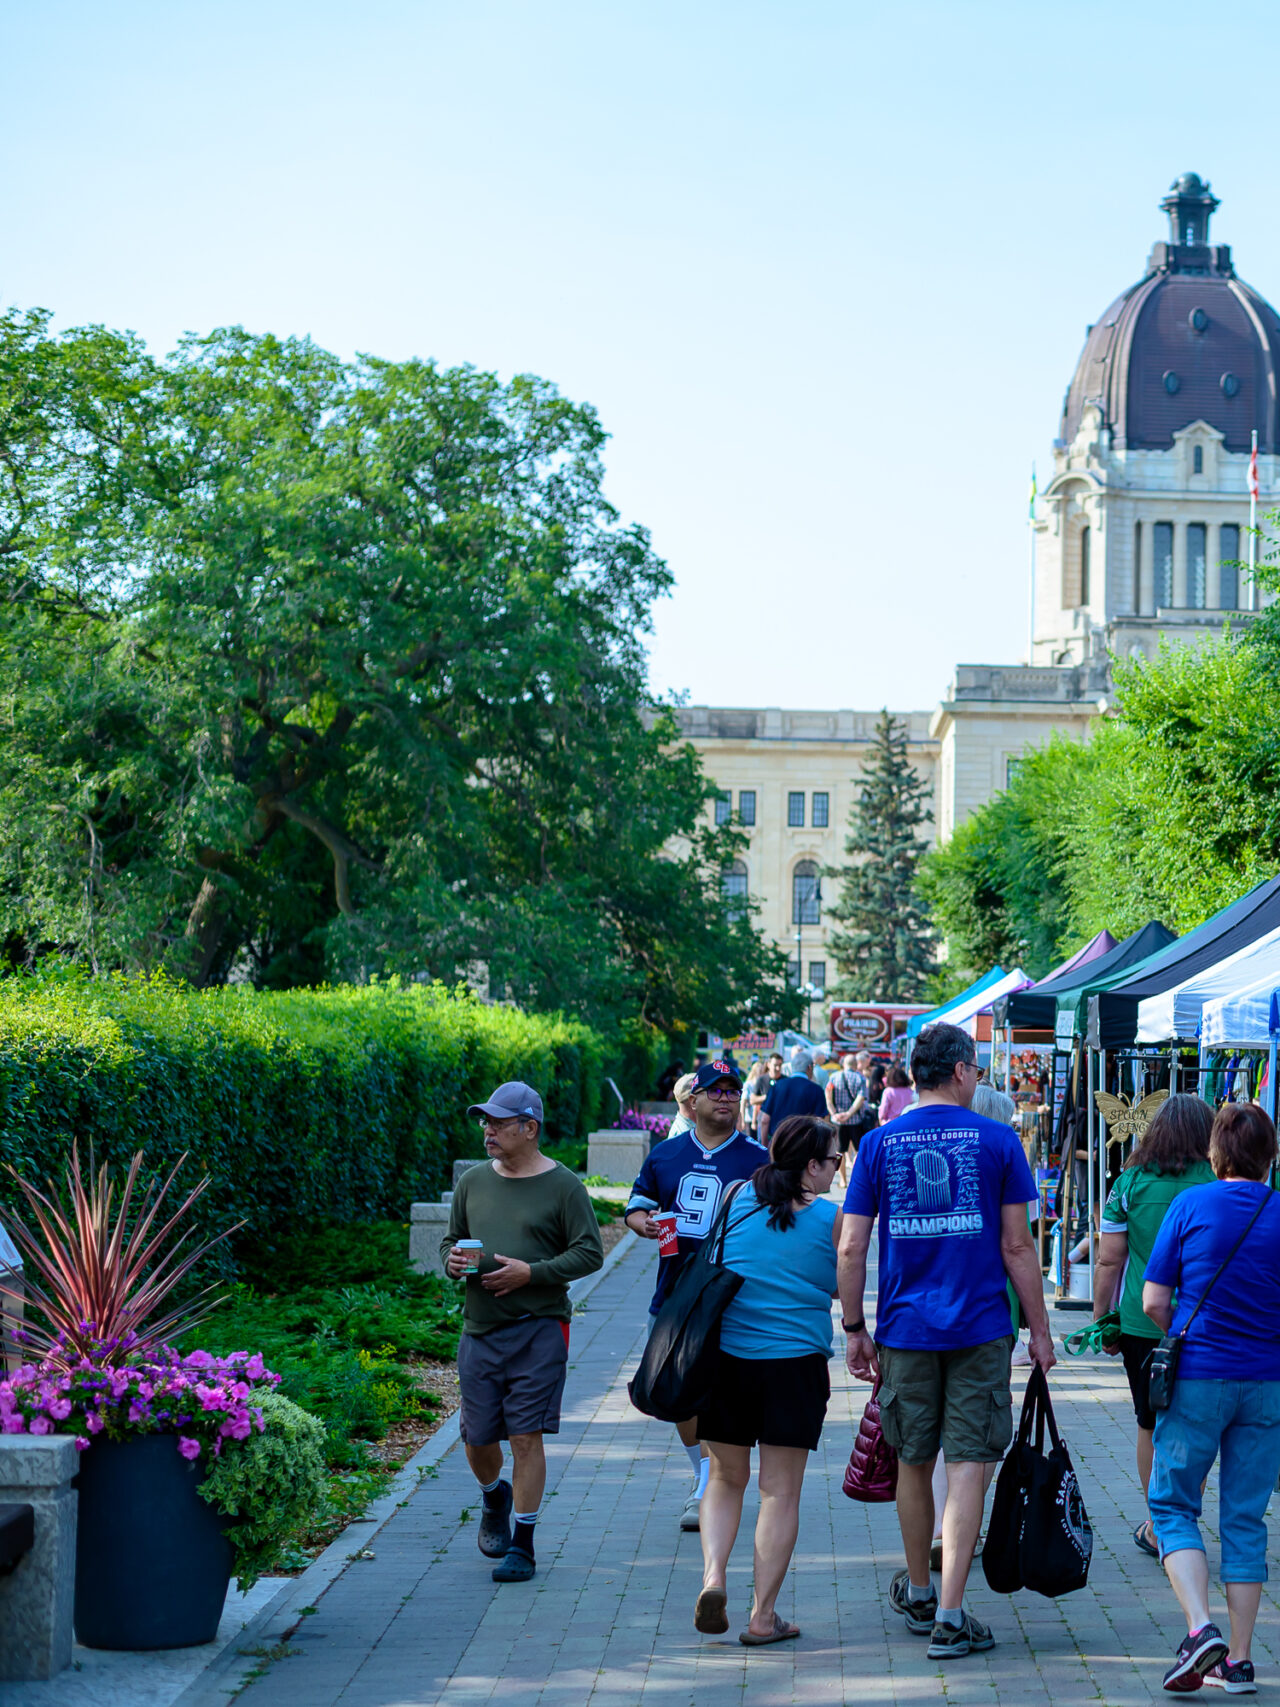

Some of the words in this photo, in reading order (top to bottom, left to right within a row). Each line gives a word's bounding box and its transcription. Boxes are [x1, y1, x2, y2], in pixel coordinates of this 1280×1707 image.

[883, 1136, 897, 1147] LOS
[900, 1133, 938, 1143] ANGELES
[941, 1131, 980, 1140] DODGERS
[674, 1171, 724, 1240] 9
[888, 1213, 984, 1236] CHAMPIONS
